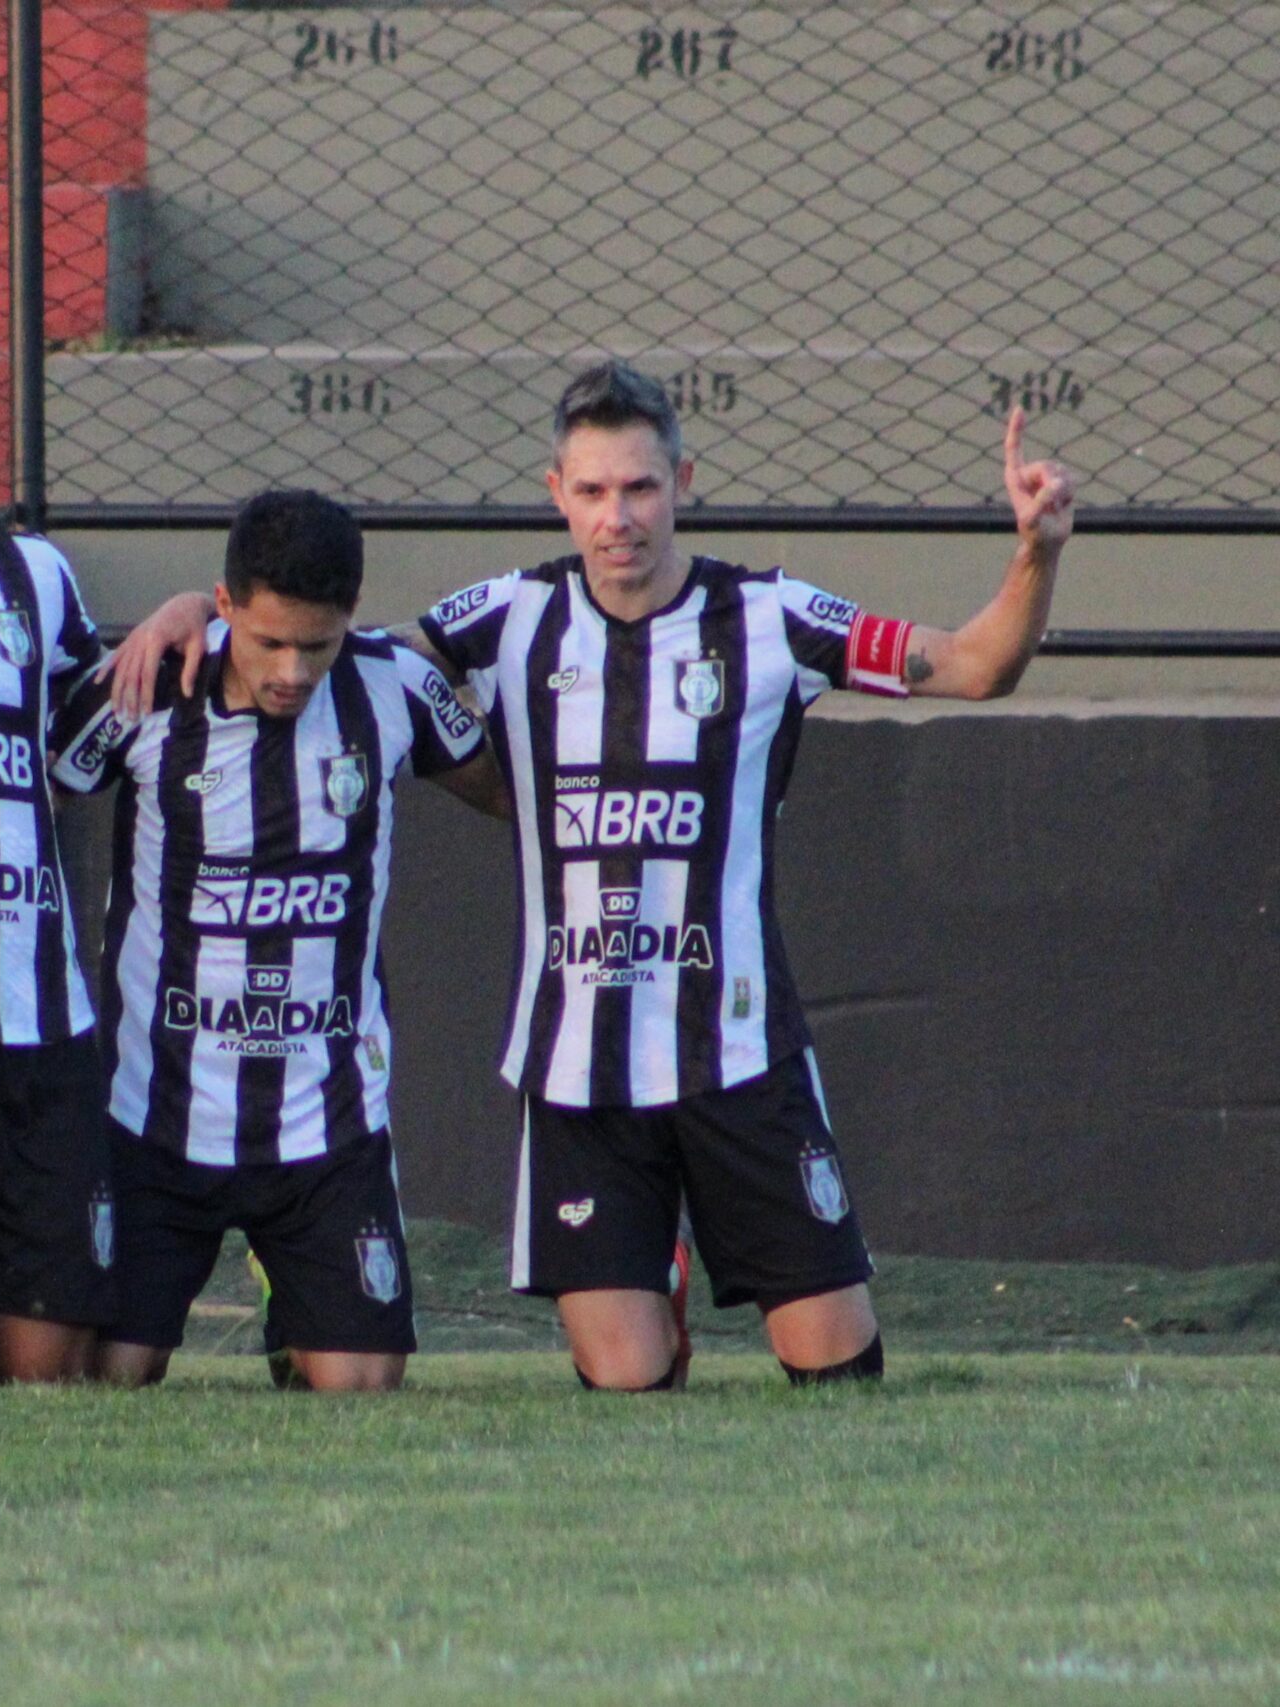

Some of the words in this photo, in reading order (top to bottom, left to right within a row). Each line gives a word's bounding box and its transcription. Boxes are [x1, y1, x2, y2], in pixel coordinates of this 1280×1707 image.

[636, 27, 738, 77] 267
[985, 29, 1084, 80] 268
[673, 371, 736, 413] 85
[981, 370, 1084, 414] 384
[555, 775, 600, 790] banco
[598, 790, 705, 846] BRB
[198, 863, 250, 877] banco
[246, 874, 352, 926] BRB
[581, 970, 656, 985] ATACADISTA
[216, 1040, 308, 1056] ATACADISTA
